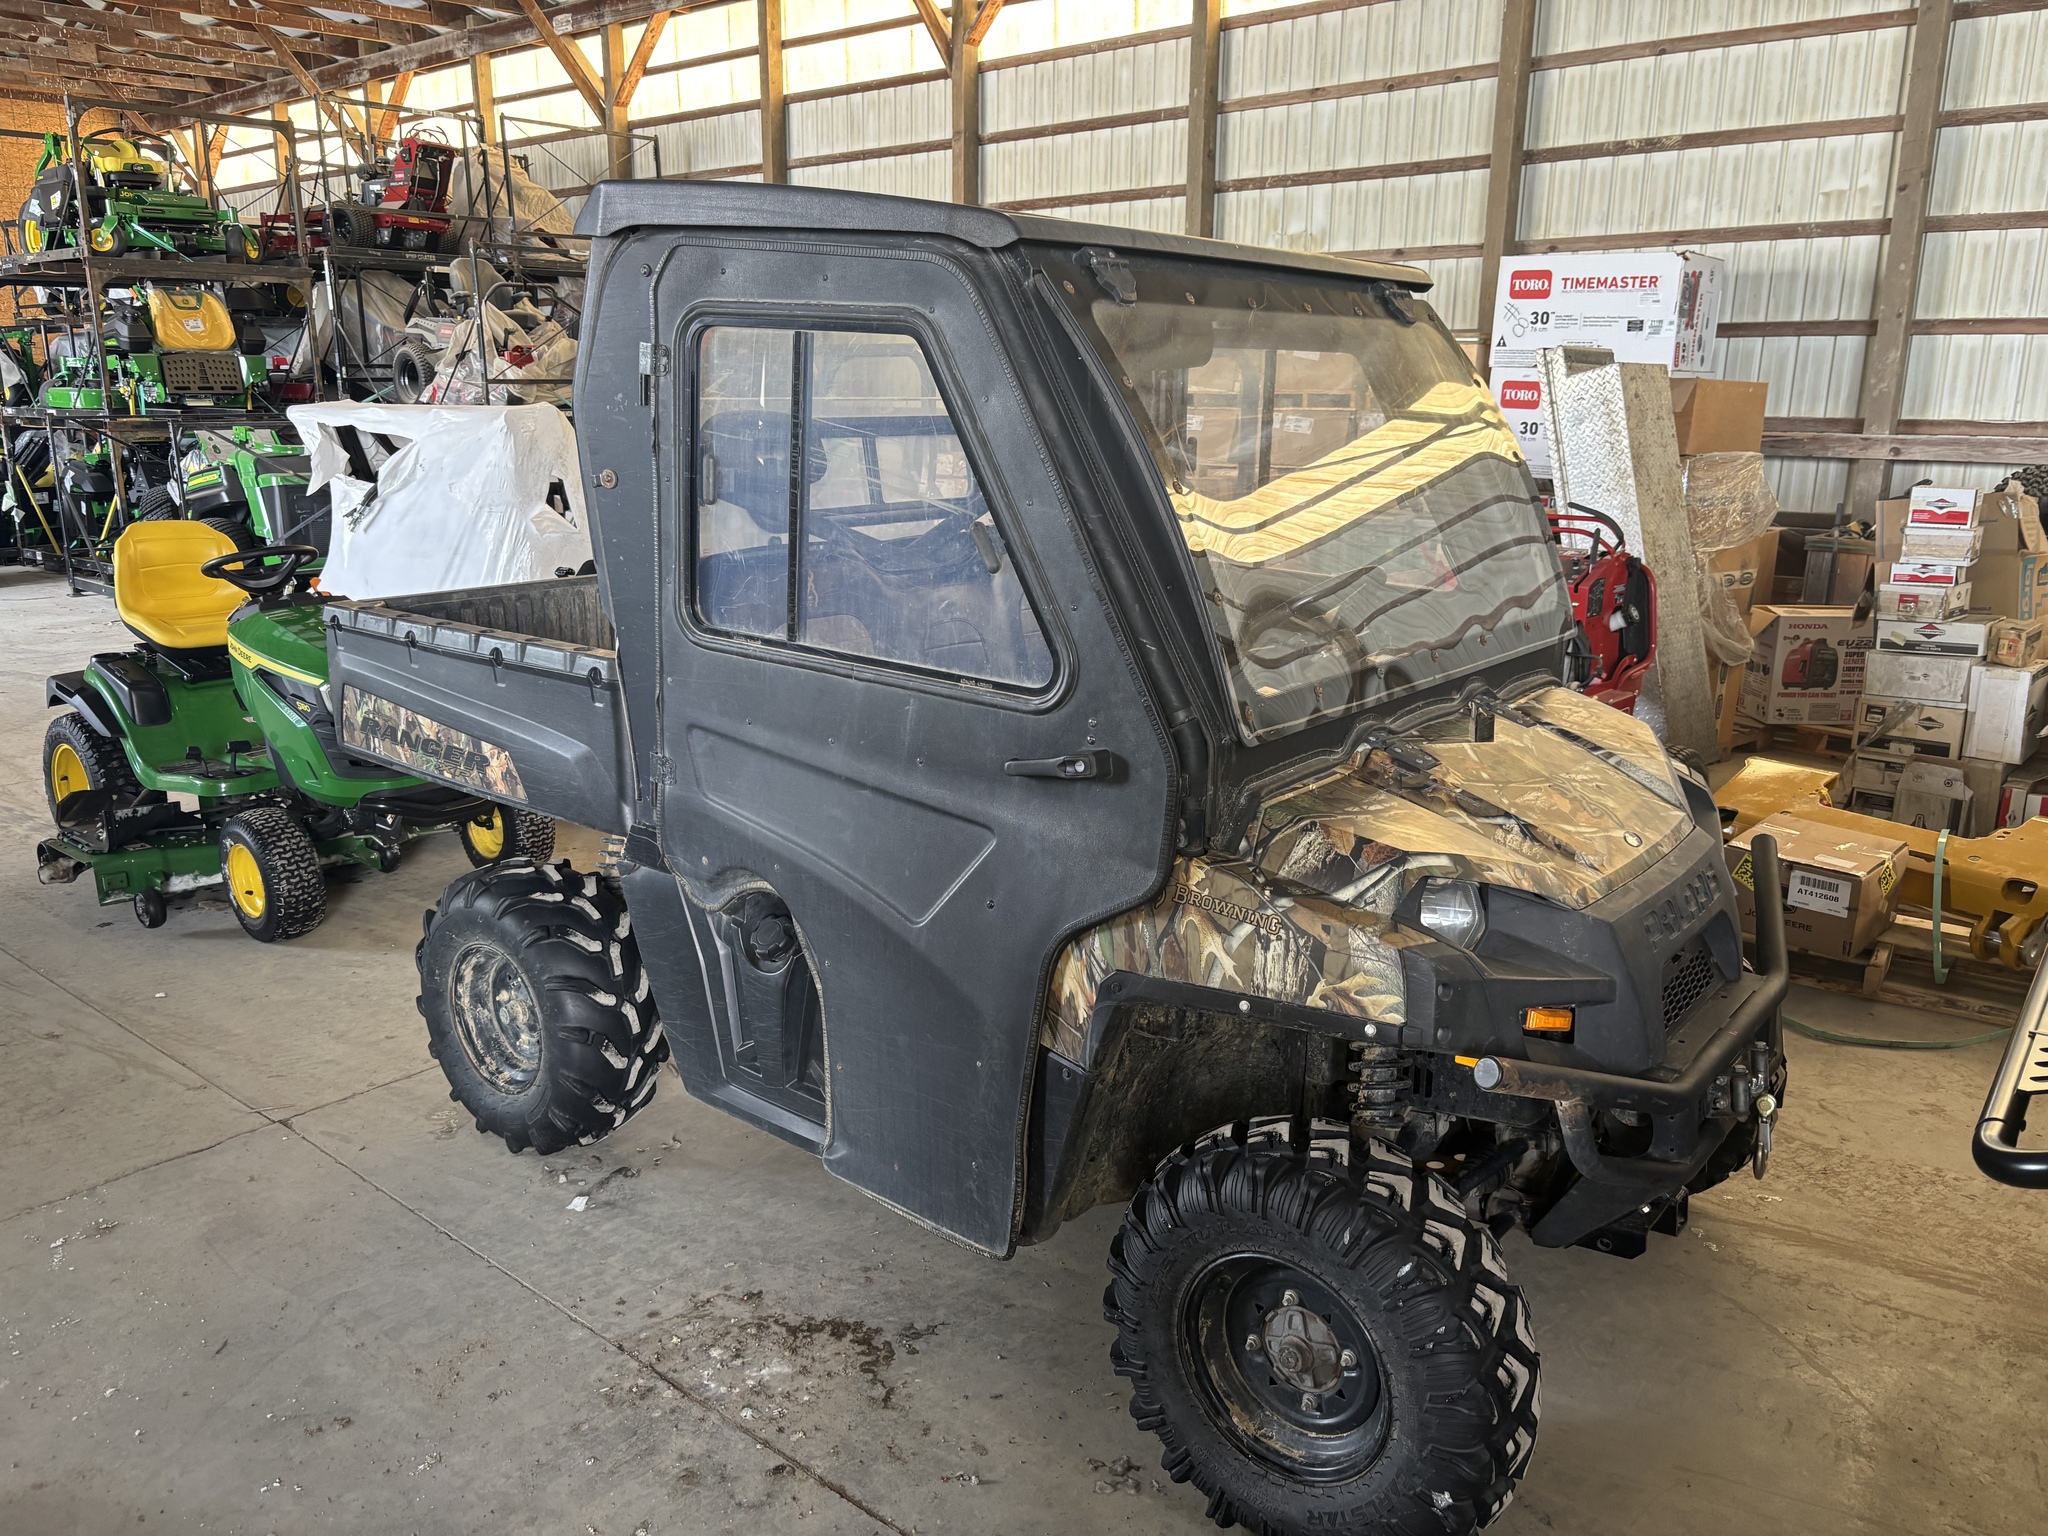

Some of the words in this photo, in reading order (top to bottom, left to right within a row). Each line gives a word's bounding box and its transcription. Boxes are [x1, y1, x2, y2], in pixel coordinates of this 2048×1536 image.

[1512, 278, 1550, 291] TORO
[1561, 275, 1659, 290] TIMEMASTER
[1503, 389, 1539, 401] TORO
[1837, 639, 1873, 647] EU22
[359, 716, 491, 775] RANGER
[1797, 887, 1840, 903] AT412608
[1172, 882, 1283, 935] BROWNING
[1643, 862, 1721, 953] POLARIS
[1784, 919, 1813, 932] EERE
[1305, 1466, 1413, 1530] CARLSTAR
